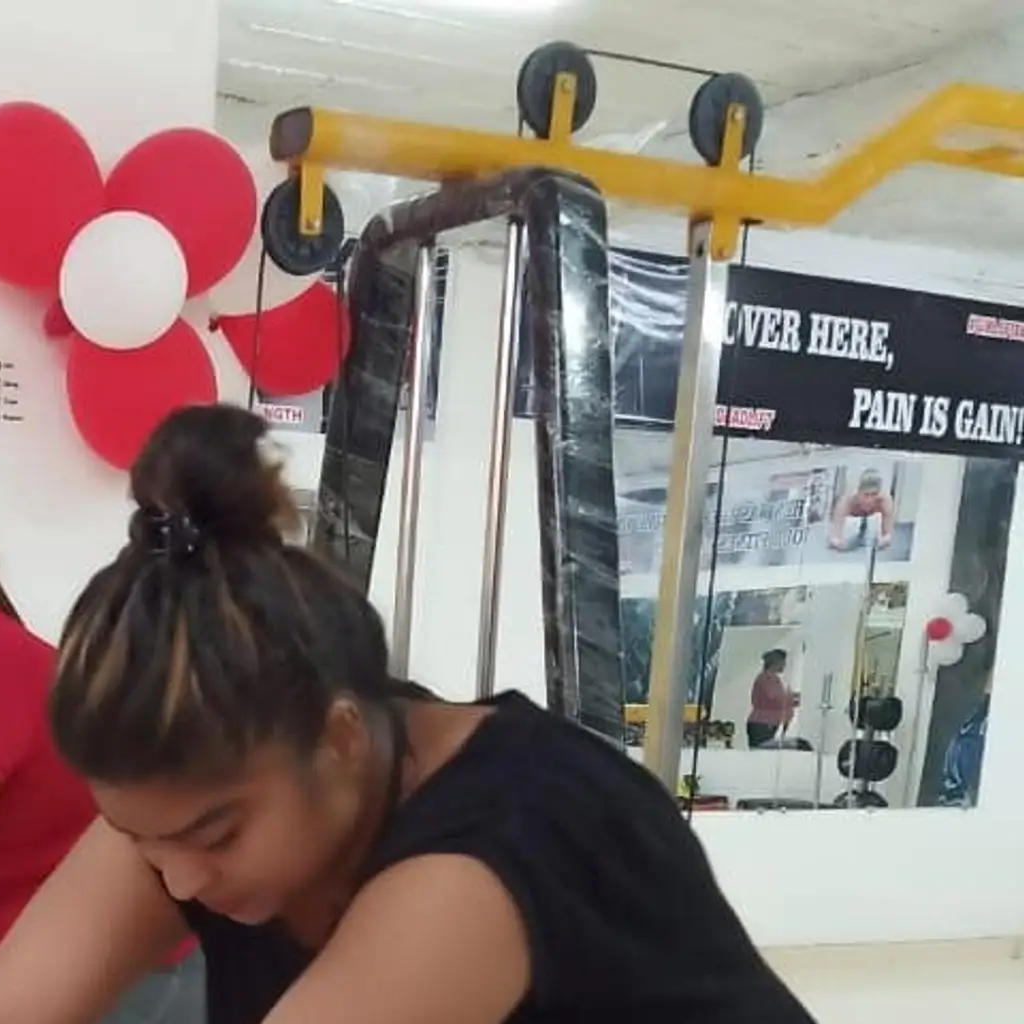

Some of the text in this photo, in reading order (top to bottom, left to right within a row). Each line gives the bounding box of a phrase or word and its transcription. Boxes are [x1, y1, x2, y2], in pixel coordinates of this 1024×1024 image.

[807, 312, 894, 371] HERE,
[848, 388, 1024, 445] PAIN IS GAIN!
